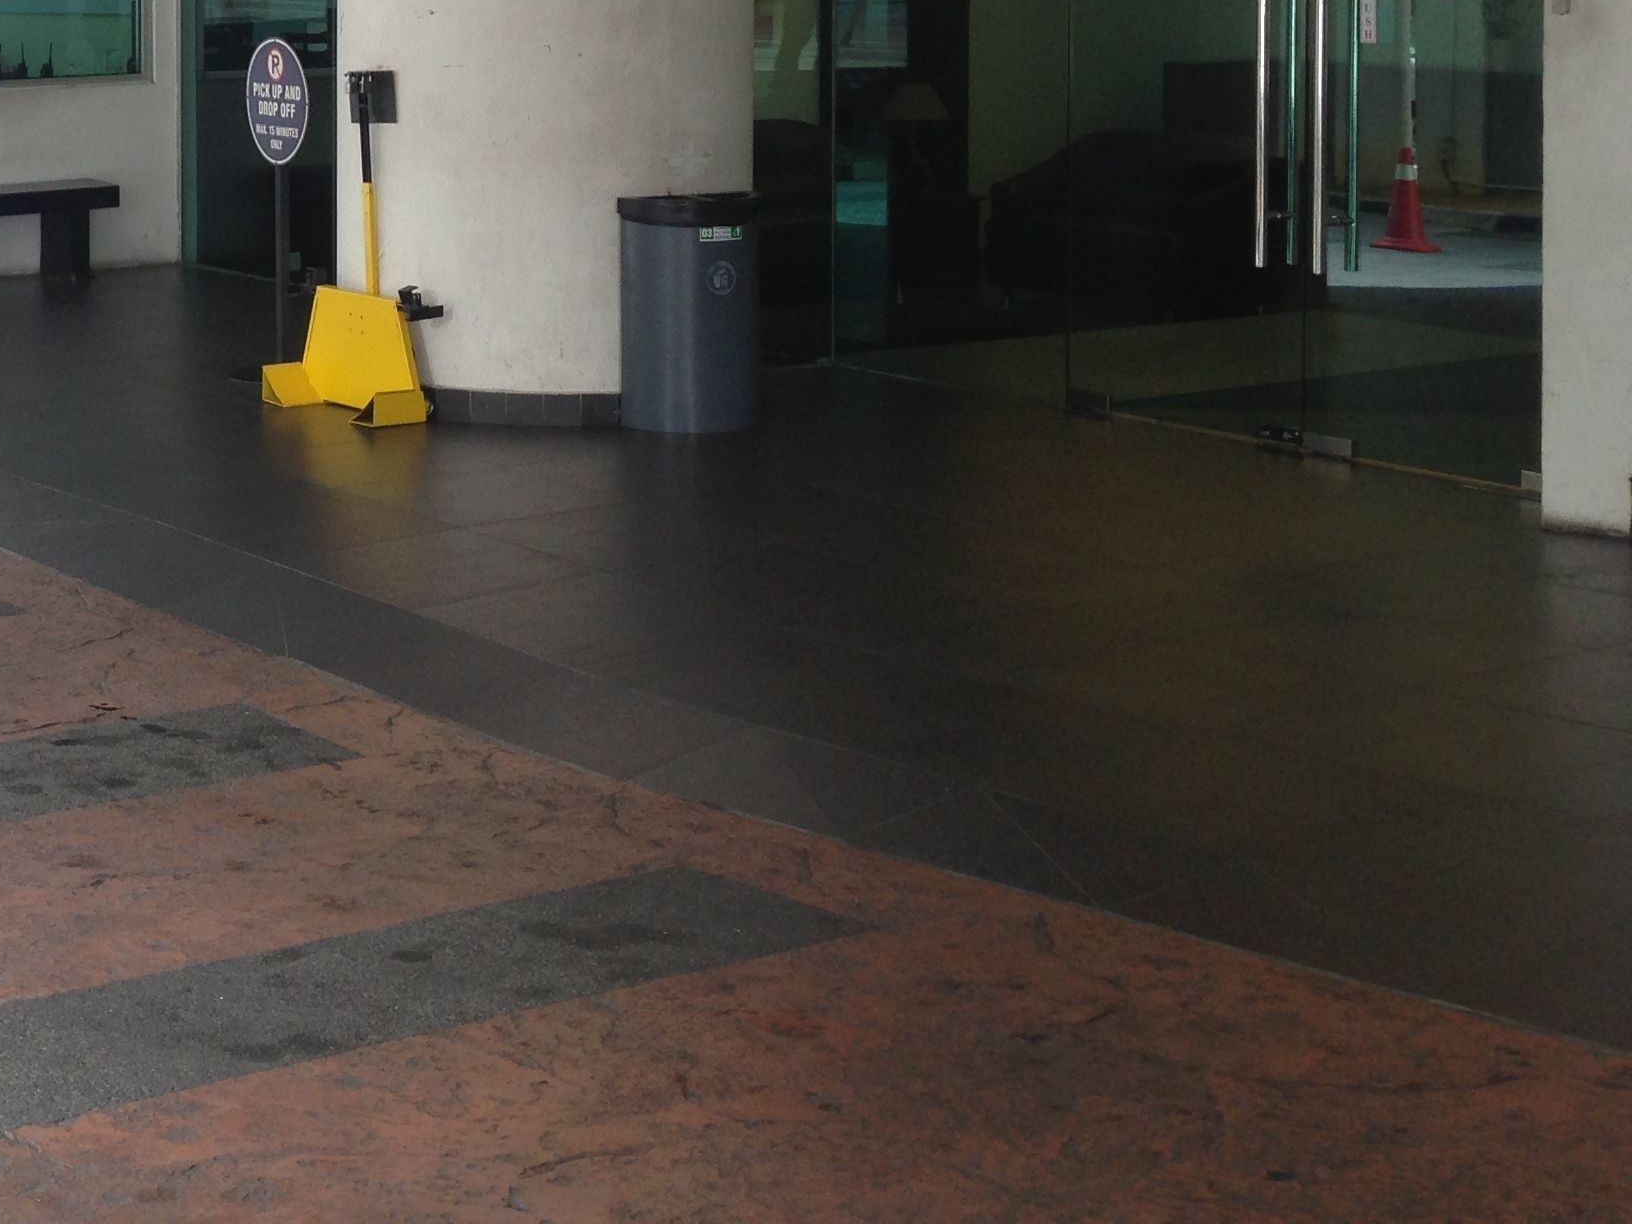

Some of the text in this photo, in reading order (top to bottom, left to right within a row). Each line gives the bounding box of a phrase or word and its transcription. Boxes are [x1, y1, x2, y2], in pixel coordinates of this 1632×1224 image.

[253, 82, 301, 100] PICK UP AND
[258, 101, 295, 118] DROP OFF
[276, 127, 298, 138] MINUTES
[271, 139, 282, 150] ONLY
[701, 228, 712, 238] 03
